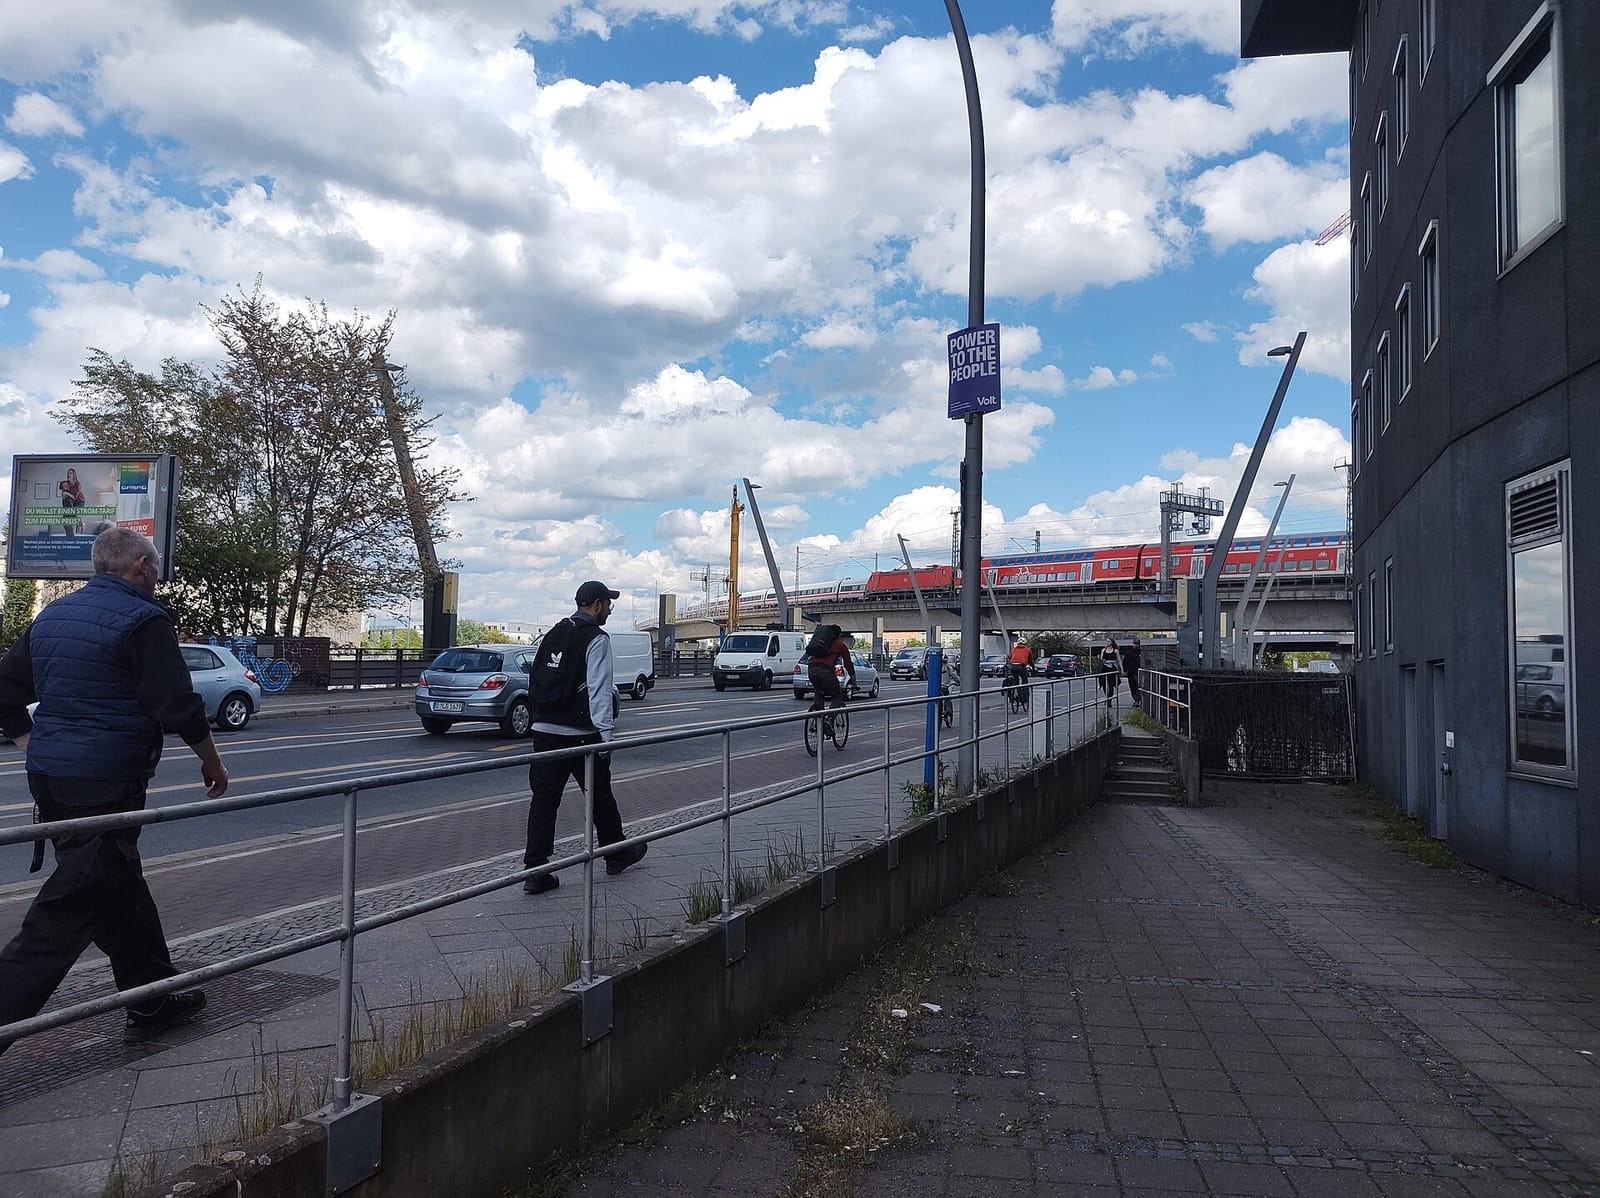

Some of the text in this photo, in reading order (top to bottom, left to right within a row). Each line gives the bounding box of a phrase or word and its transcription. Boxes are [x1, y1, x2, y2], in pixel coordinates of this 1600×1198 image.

[950, 330, 995, 353] POWER
[951, 345, 996, 368] TO THE
[951, 361, 996, 384] PEOPLE
[977, 395, 996, 406] Volt
